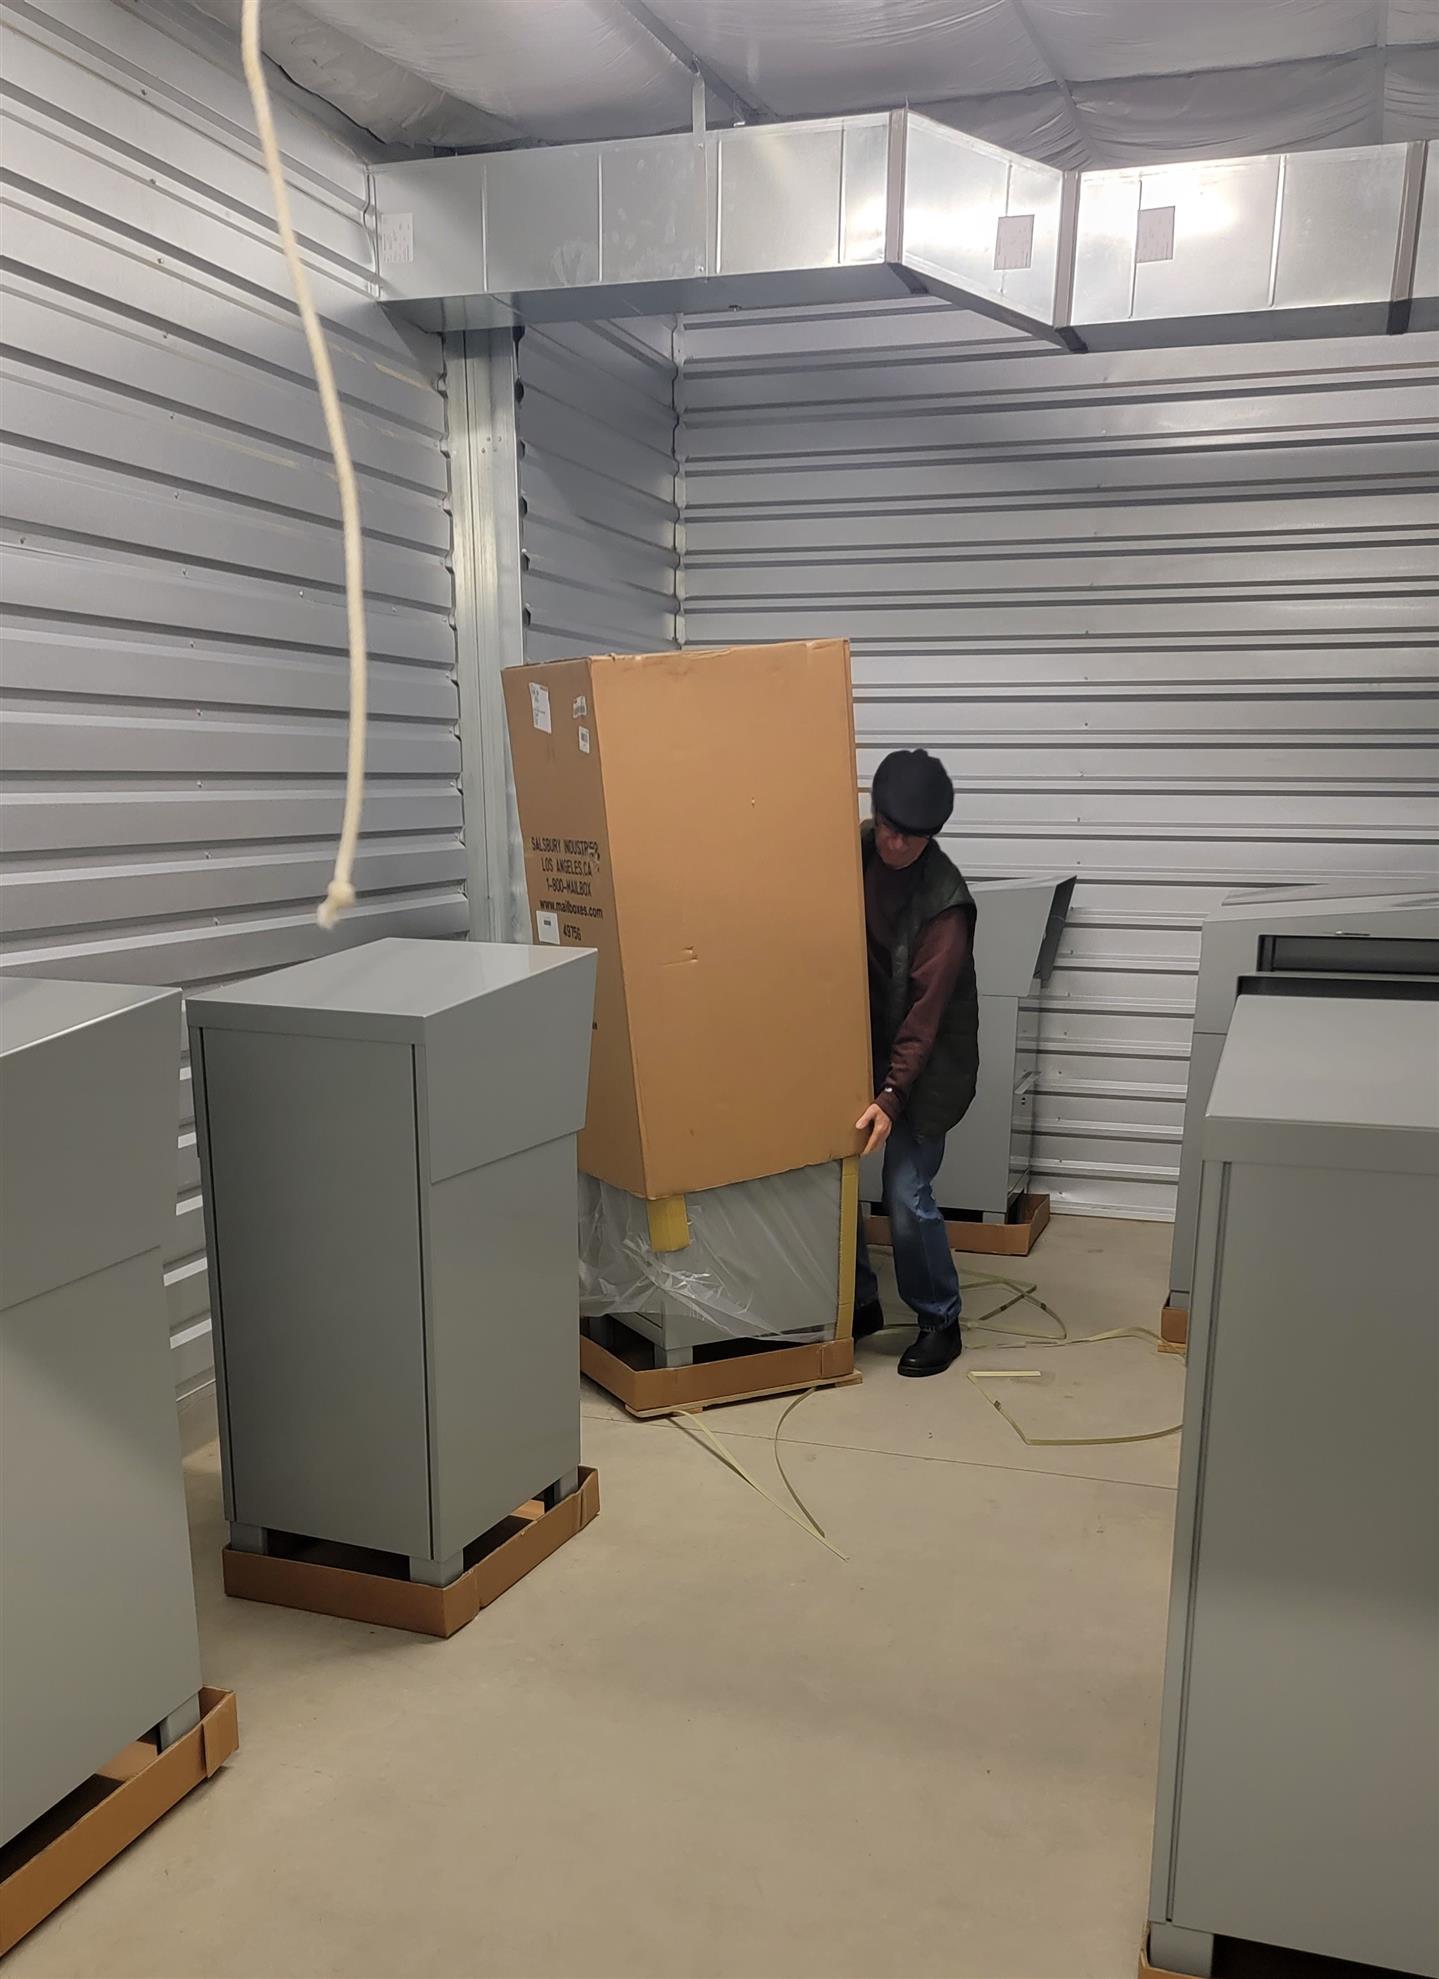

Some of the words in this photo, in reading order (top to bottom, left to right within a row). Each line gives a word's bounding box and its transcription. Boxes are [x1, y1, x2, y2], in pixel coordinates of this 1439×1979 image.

[531, 836, 561, 853] SALSBURY
[541, 857, 554, 872] LOS
[546, 877, 592, 897] 1-800-MAILBOX
[539, 900, 604, 919] www.mailboxes.com
